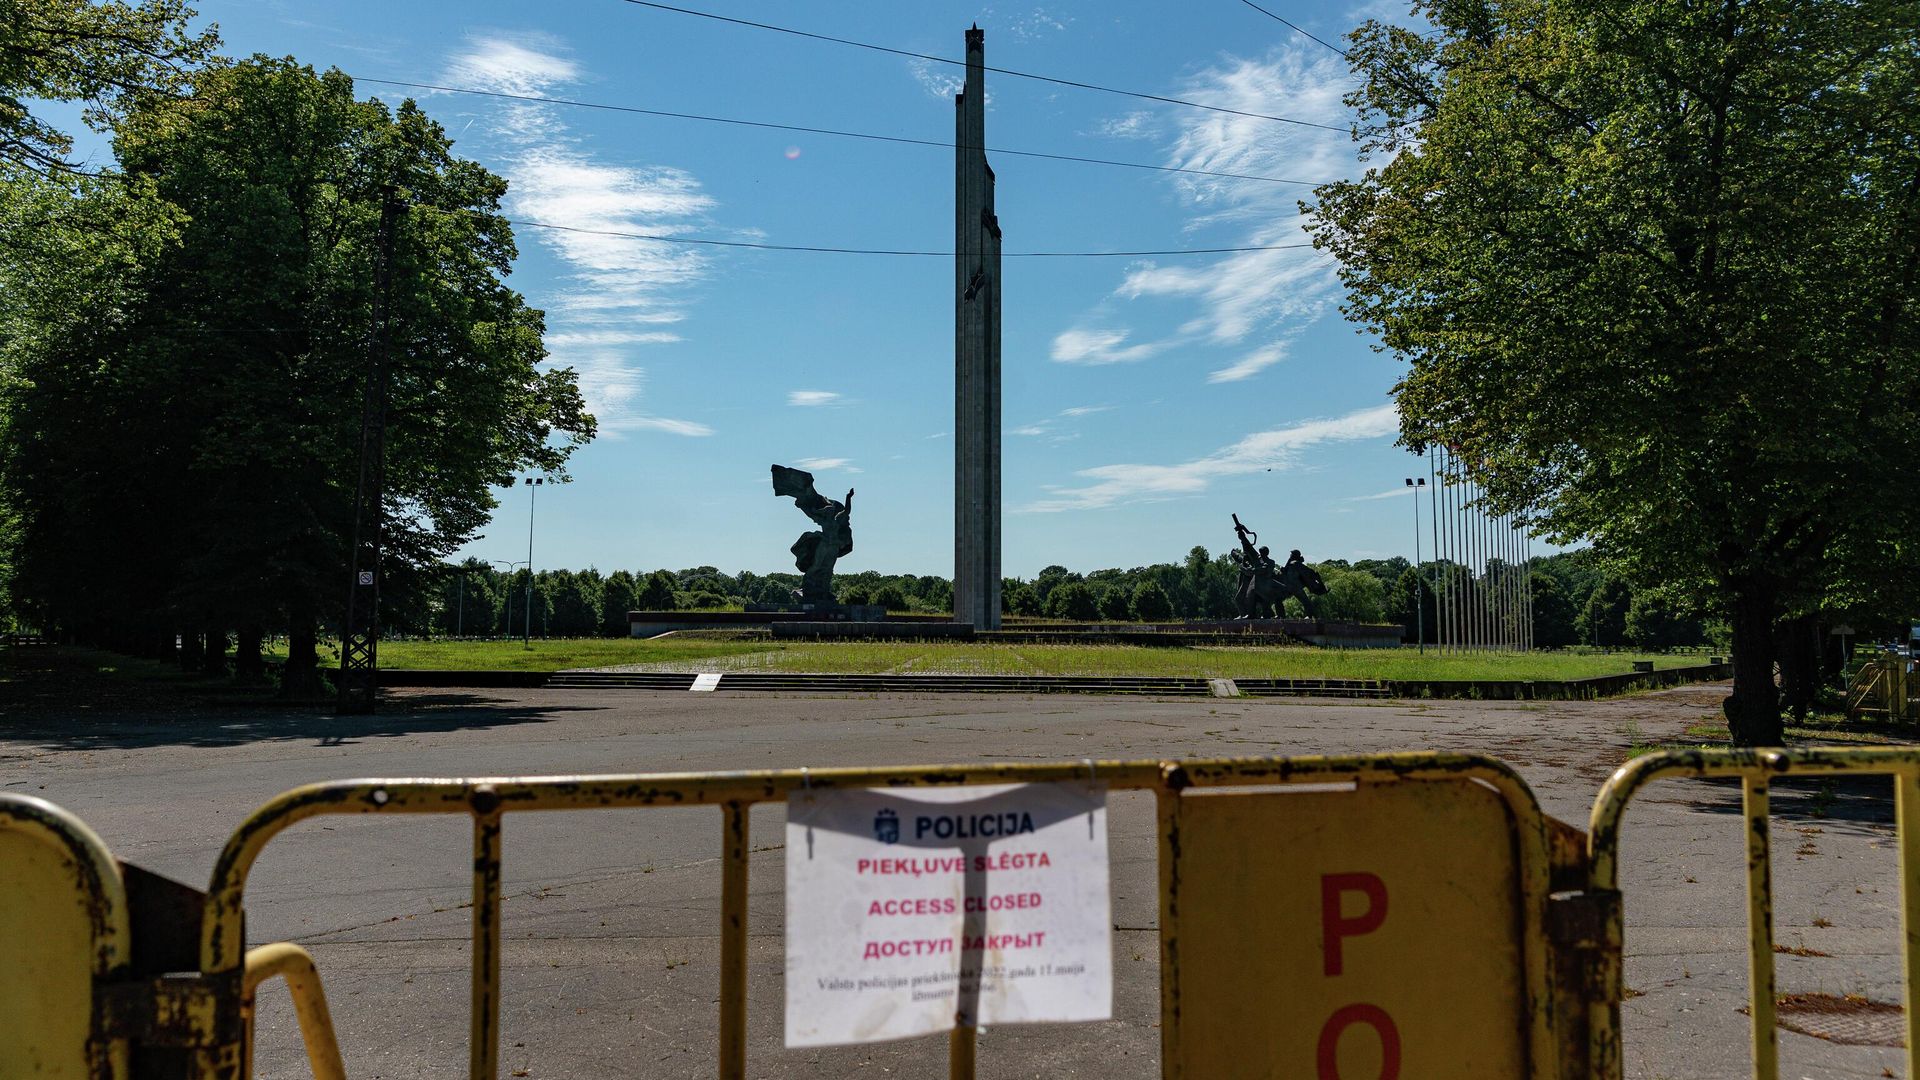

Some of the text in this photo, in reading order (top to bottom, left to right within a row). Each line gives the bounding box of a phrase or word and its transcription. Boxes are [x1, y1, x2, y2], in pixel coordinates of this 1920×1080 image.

[915, 812, 1035, 840] POLICIJA
[858, 851, 1051, 877] PIEKĻUVE SLĒGTA
[868, 892, 1042, 916] ACCESS CLOSED
[863, 932, 1045, 960] ДОСТУП ЗАКРЫТ
